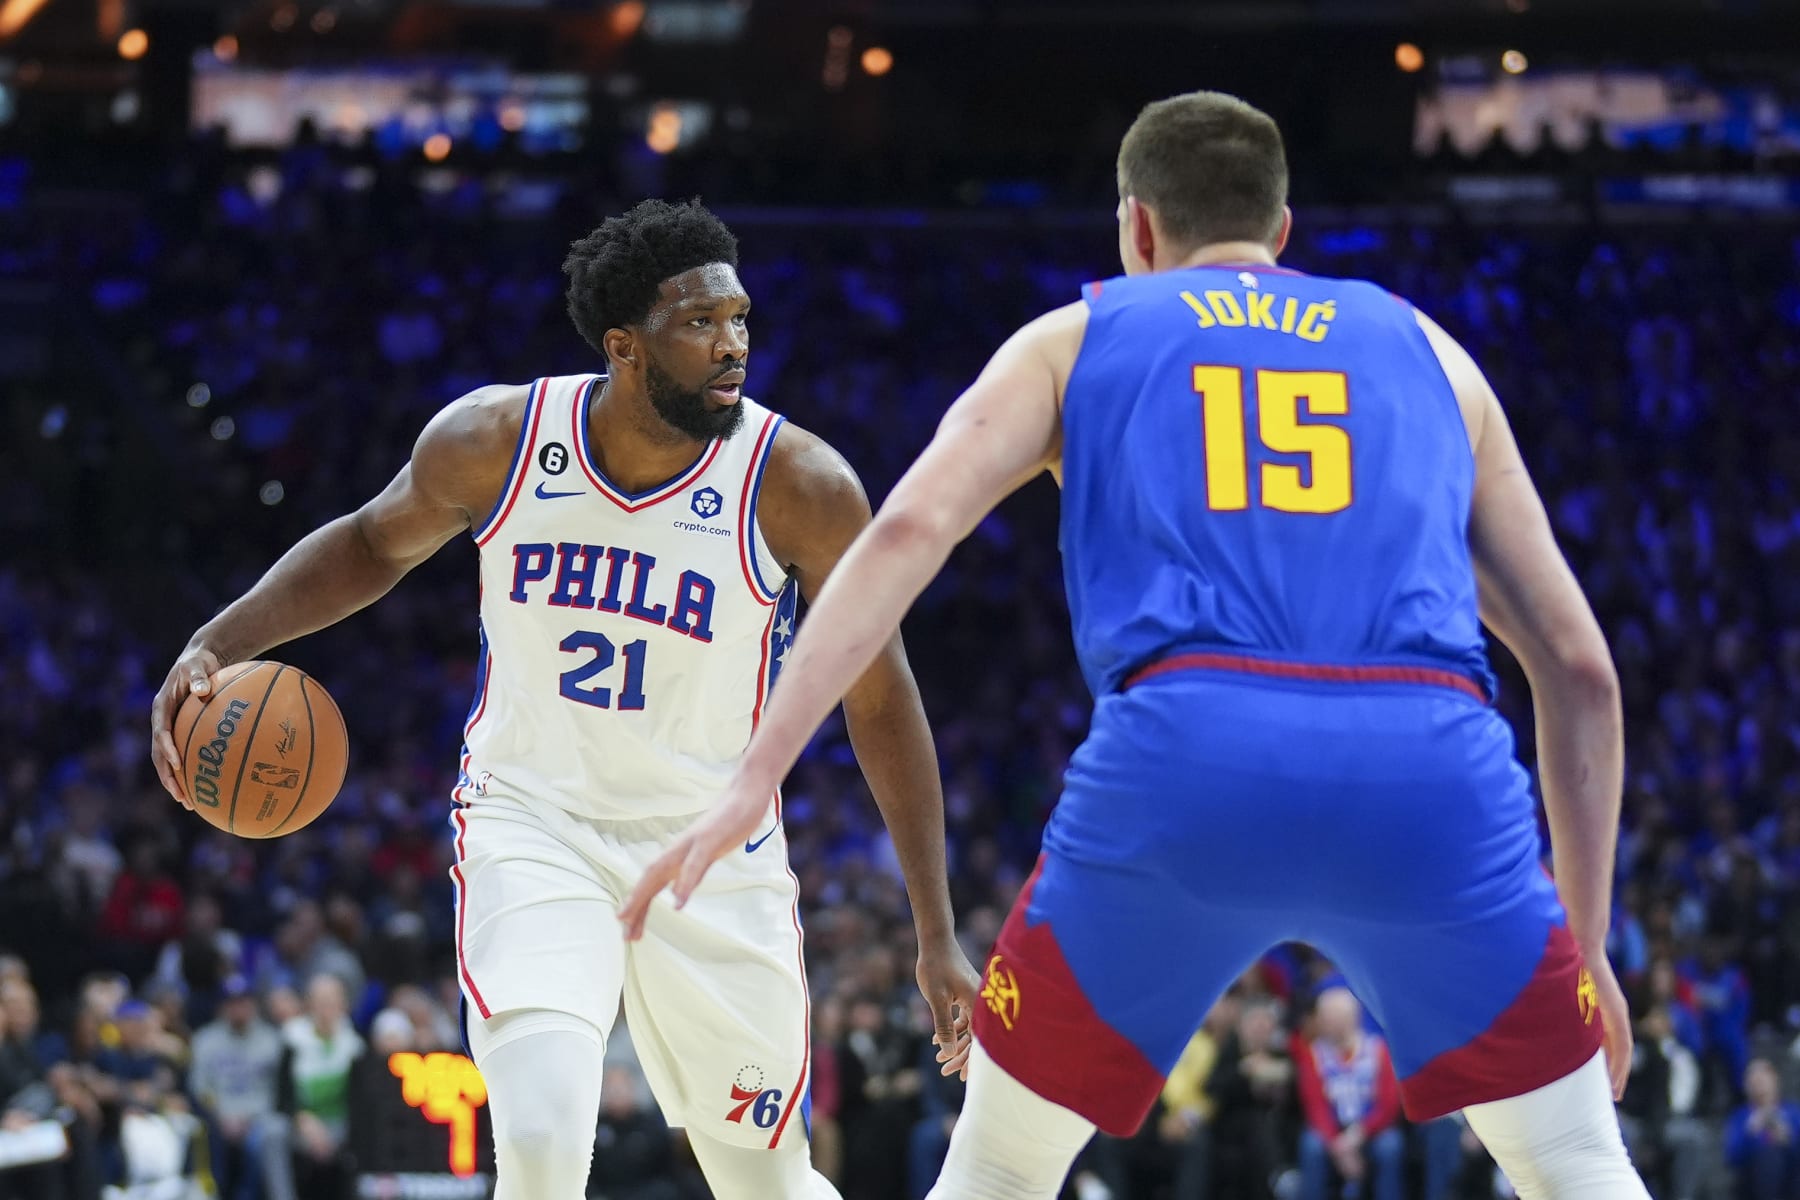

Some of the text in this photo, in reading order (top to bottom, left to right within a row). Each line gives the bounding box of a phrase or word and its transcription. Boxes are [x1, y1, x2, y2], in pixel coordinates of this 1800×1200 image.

[1179, 290, 1337, 342] JOKIĆ
[545, 446, 564, 472] 6
[1191, 364, 1354, 514] 15
[673, 521, 731, 537] crypto.com
[509, 542, 716, 643] PHILA
[559, 630, 647, 711] 21
[194, 699, 250, 809] Wilson
[725, 1083, 783, 1129] 76
